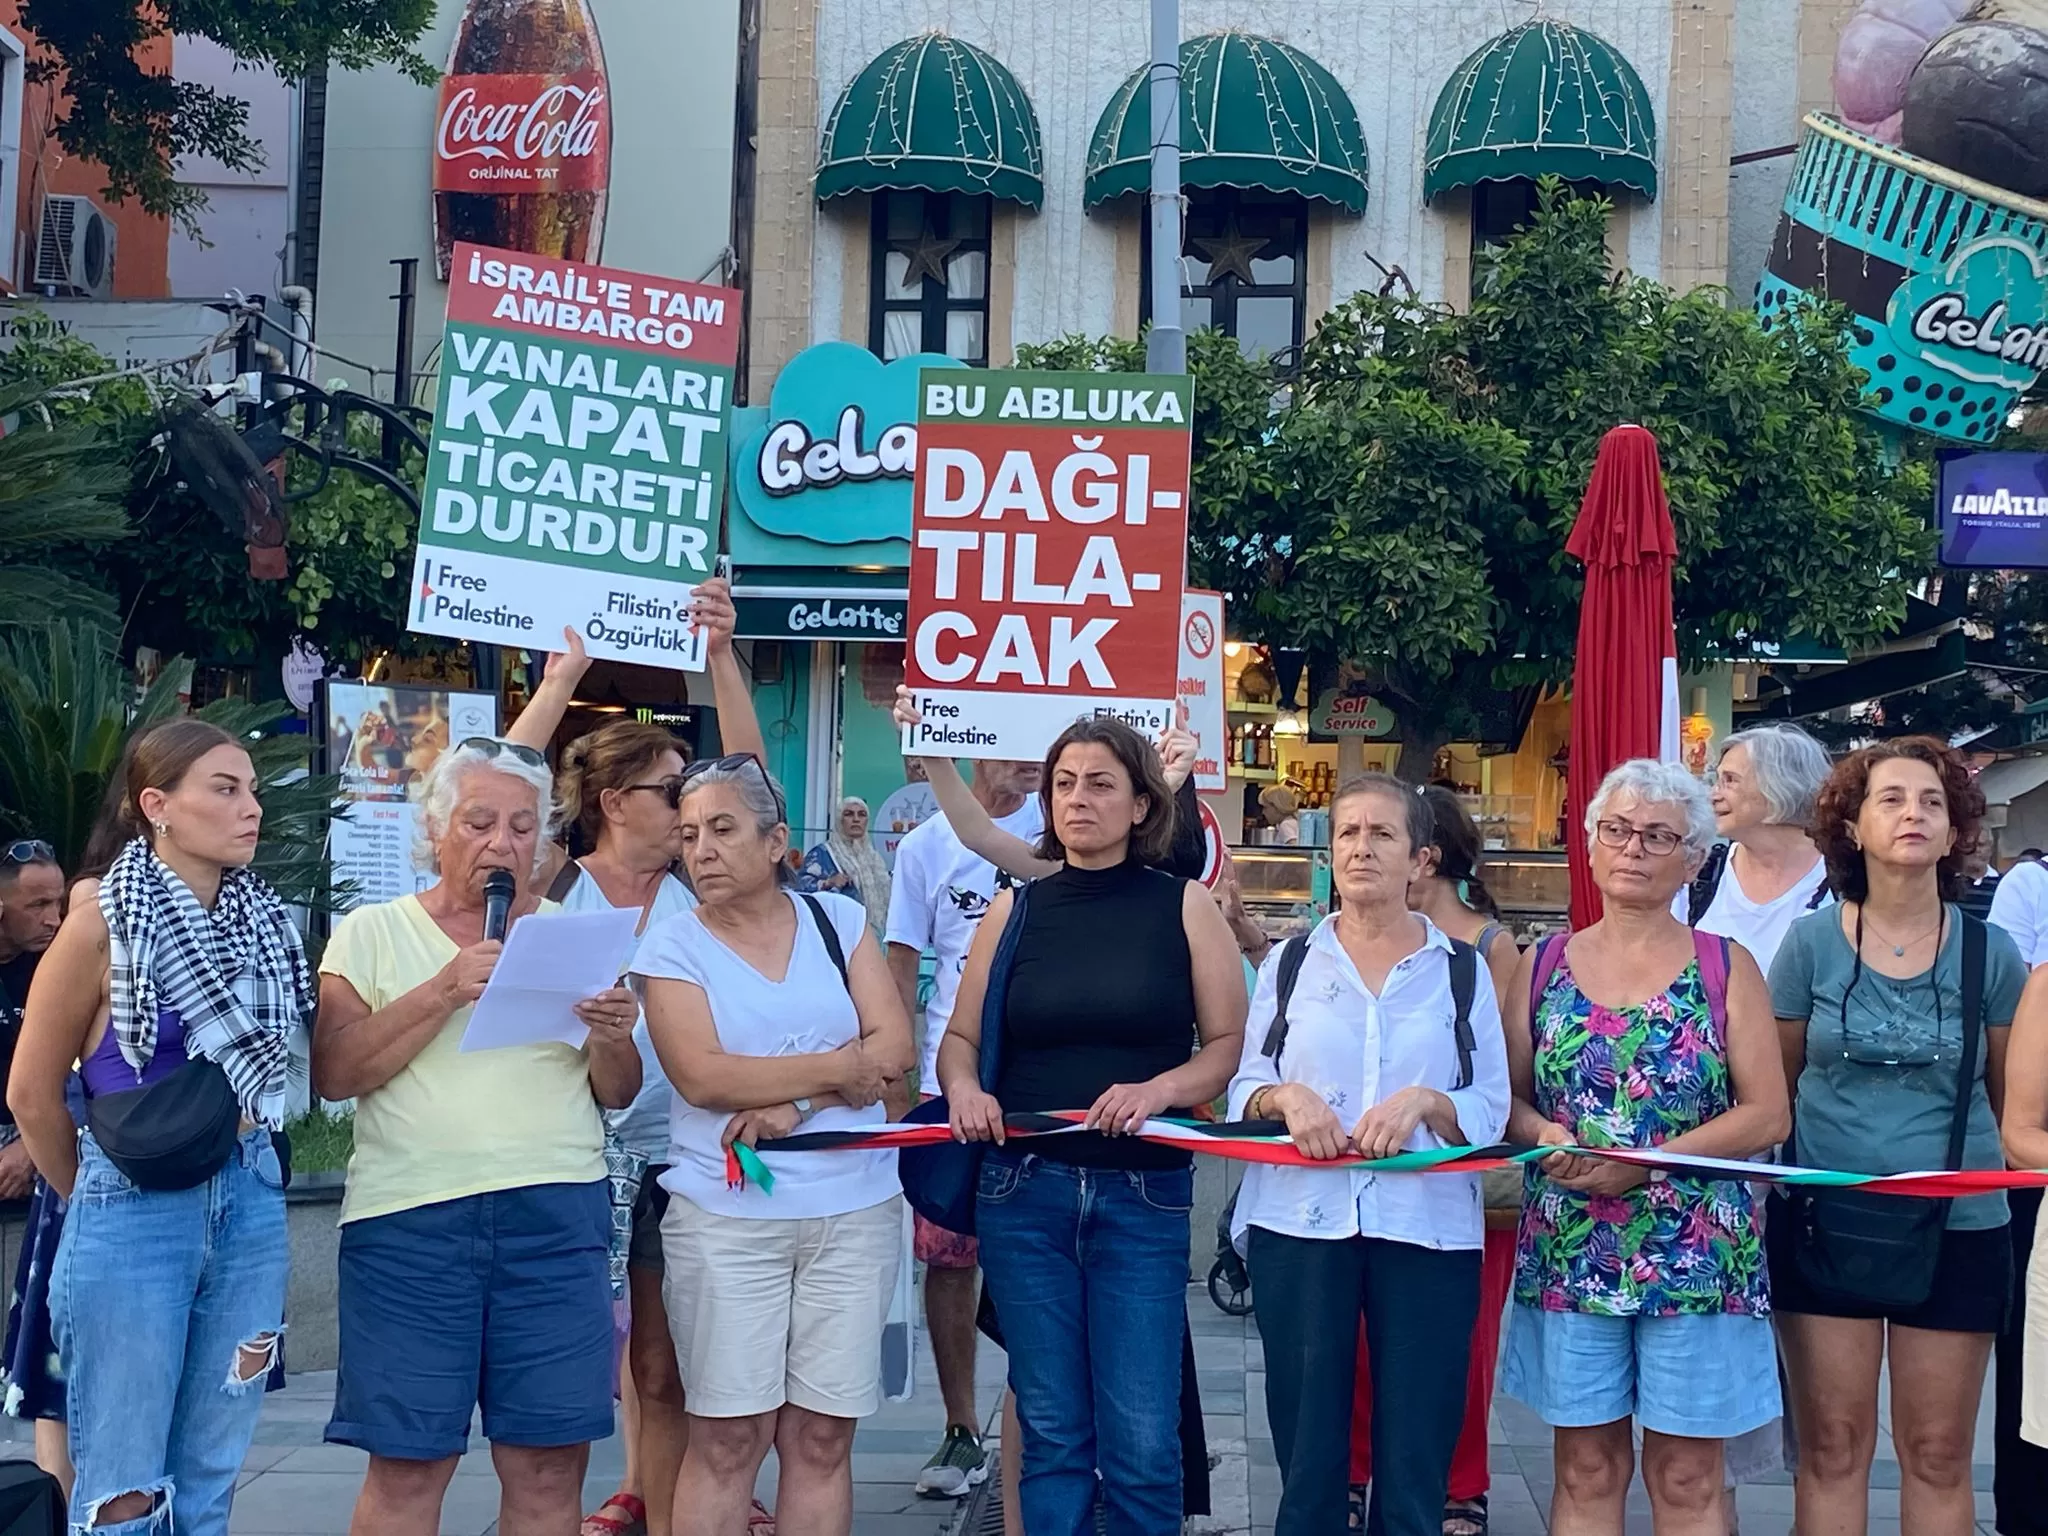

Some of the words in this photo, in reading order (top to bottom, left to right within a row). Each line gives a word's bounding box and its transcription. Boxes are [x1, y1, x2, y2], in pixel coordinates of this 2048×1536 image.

[438, 84, 604, 160] Coca-Cola
[535, 168, 560, 179] TAT
[492, 293, 693, 350] AMBARGO
[643, 287, 725, 326] TAM
[451, 332, 725, 412] VANALARI
[444, 375, 721, 468] KAPAT
[926, 384, 986, 418] BU
[999, 386, 1184, 423] ABLUKA
[438, 437, 712, 521] TİCARETİ
[923, 434, 1181, 525] DAĞI-
[432, 487, 709, 572] DURDUR
[437, 565, 487, 592] Free
[917, 529, 1161, 607] TILA-
[435, 595, 534, 631] Palestine
[586, 613, 687, 653] Özgürlük
[914, 610, 1120, 689] CAK
[922, 698, 960, 718] Free
[1324, 716, 1377, 730] Service
[1332, 697, 1368, 714] Self
[921, 723, 997, 746] Palestine
